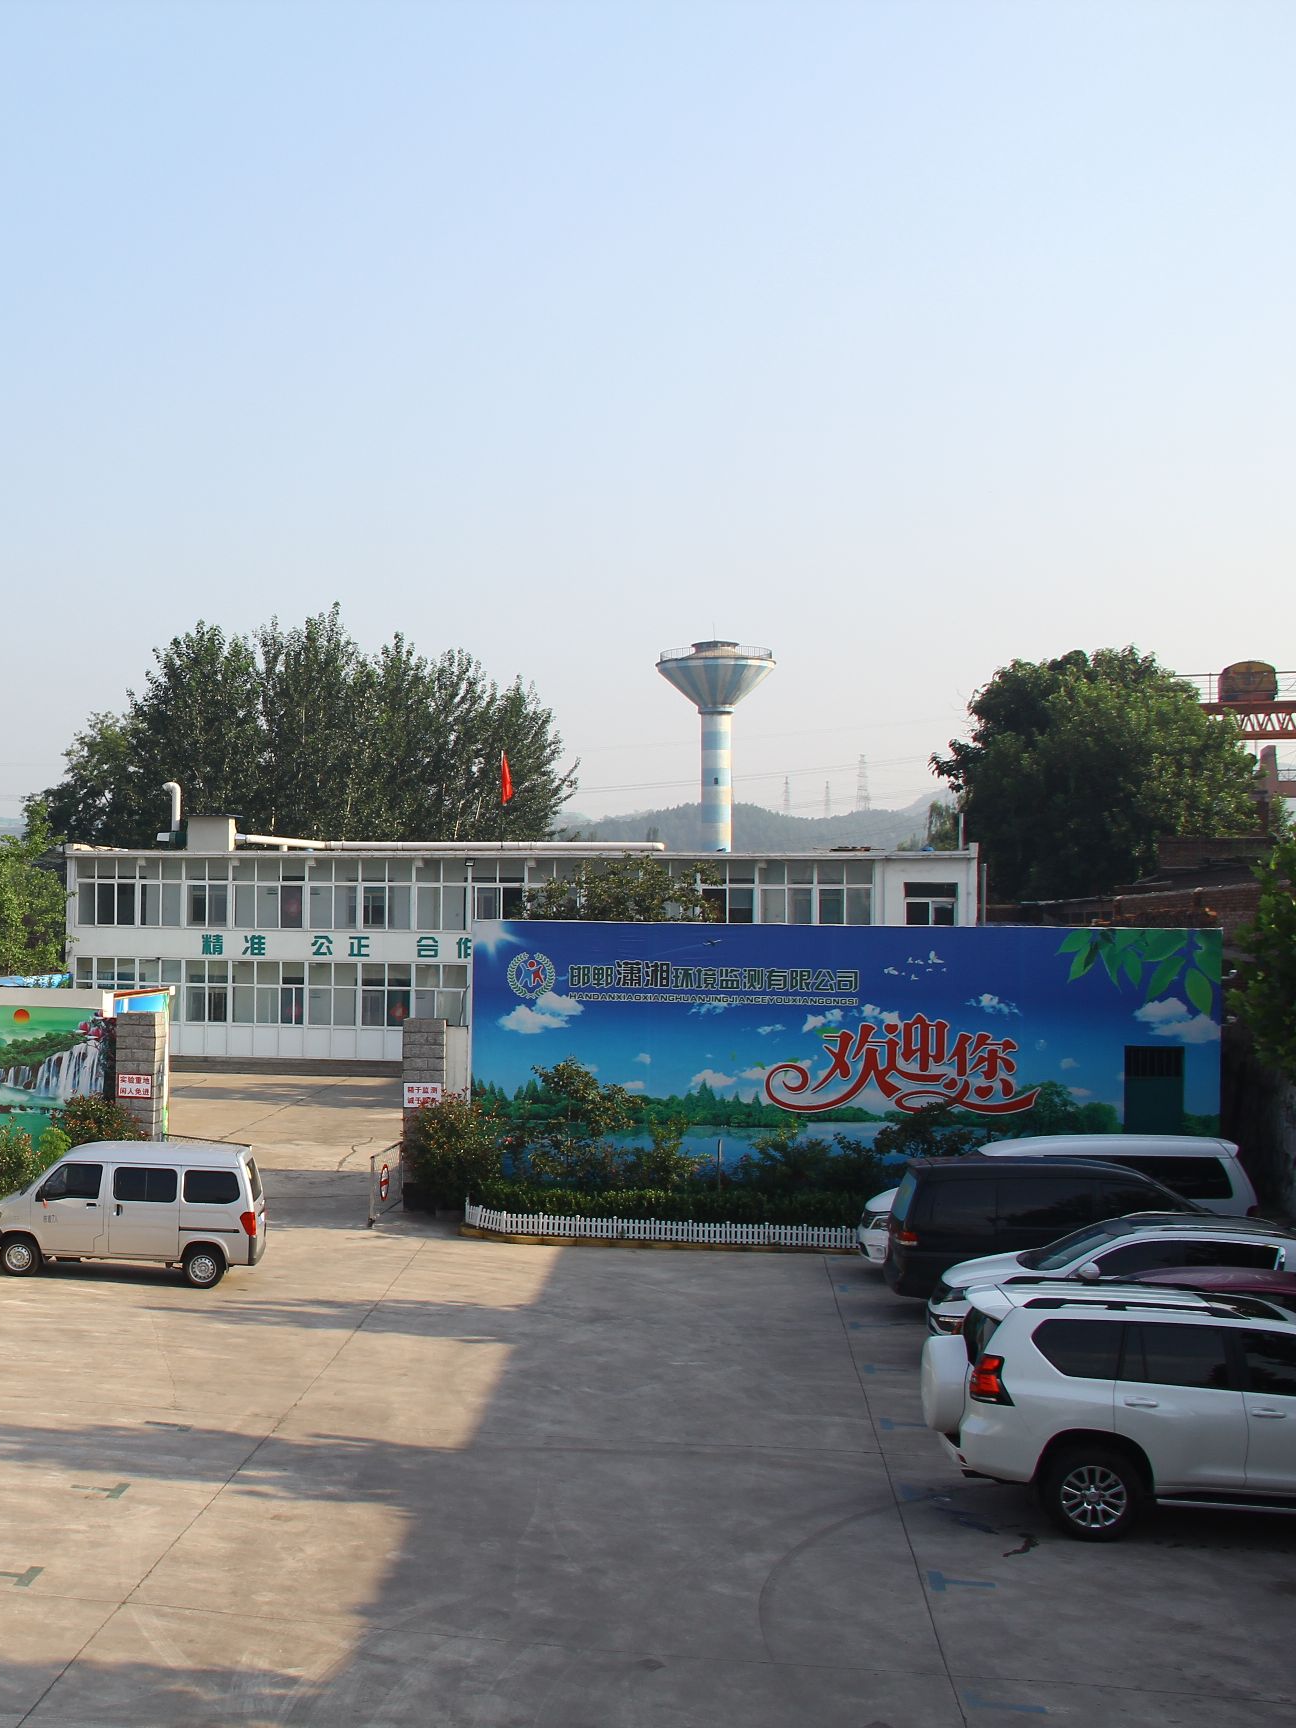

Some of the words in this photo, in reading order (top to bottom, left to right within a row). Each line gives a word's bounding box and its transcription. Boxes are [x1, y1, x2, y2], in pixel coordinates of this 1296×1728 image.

[201, 934, 266, 956] 精准
[311, 935, 370, 958] 公正
[569, 960, 859, 992] 邯郸潇湘环境监测有限公司
[569, 992, 858, 1005] HANDANXIAOXIANGHUANJINGJIANCEYOUXIANGONGSI
[765, 1013, 1042, 1114] 欢迎您
[120, 1076, 150, 1084] 实验重地
[120, 1087, 150, 1095] 闲人免进
